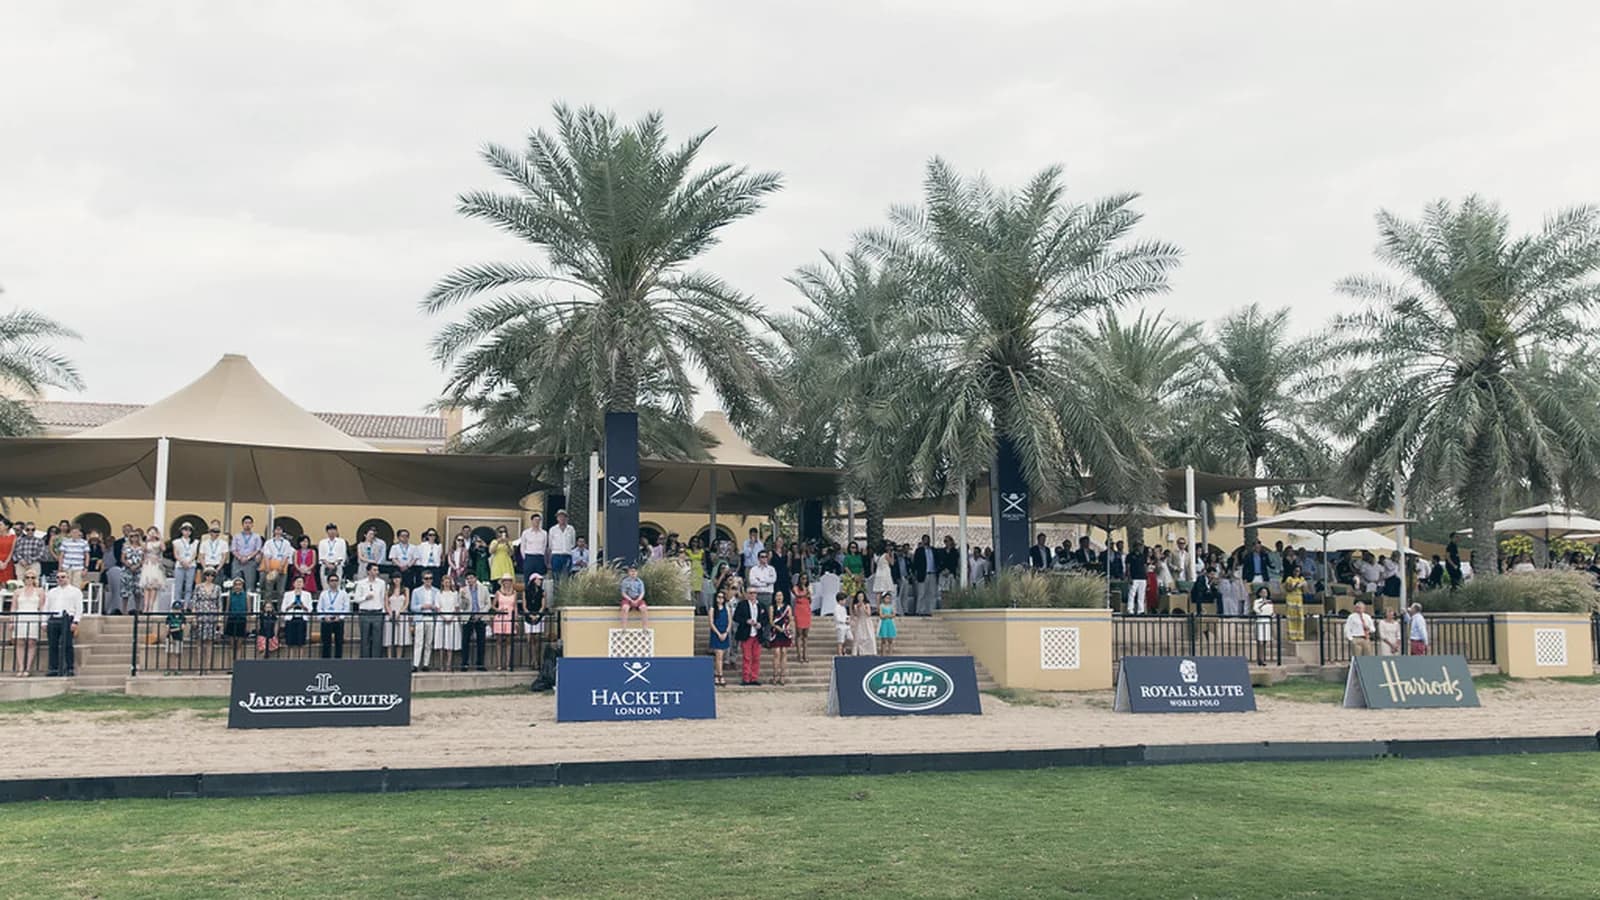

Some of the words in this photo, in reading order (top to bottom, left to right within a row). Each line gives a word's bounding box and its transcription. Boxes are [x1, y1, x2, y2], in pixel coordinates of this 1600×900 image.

[882, 671, 923, 685] LAND
[1378, 660, 1463, 702] Harrods
[591, 689, 683, 705] HACKETT
[887, 685, 937, 698] ROVER
[1140, 685, 1188, 698] ROYAL
[1189, 684, 1244, 697] SALUTE
[1169, 699, 1198, 707] WORLD
[1199, 699, 1220, 707] POLO
[615, 707, 662, 716] LONDON
